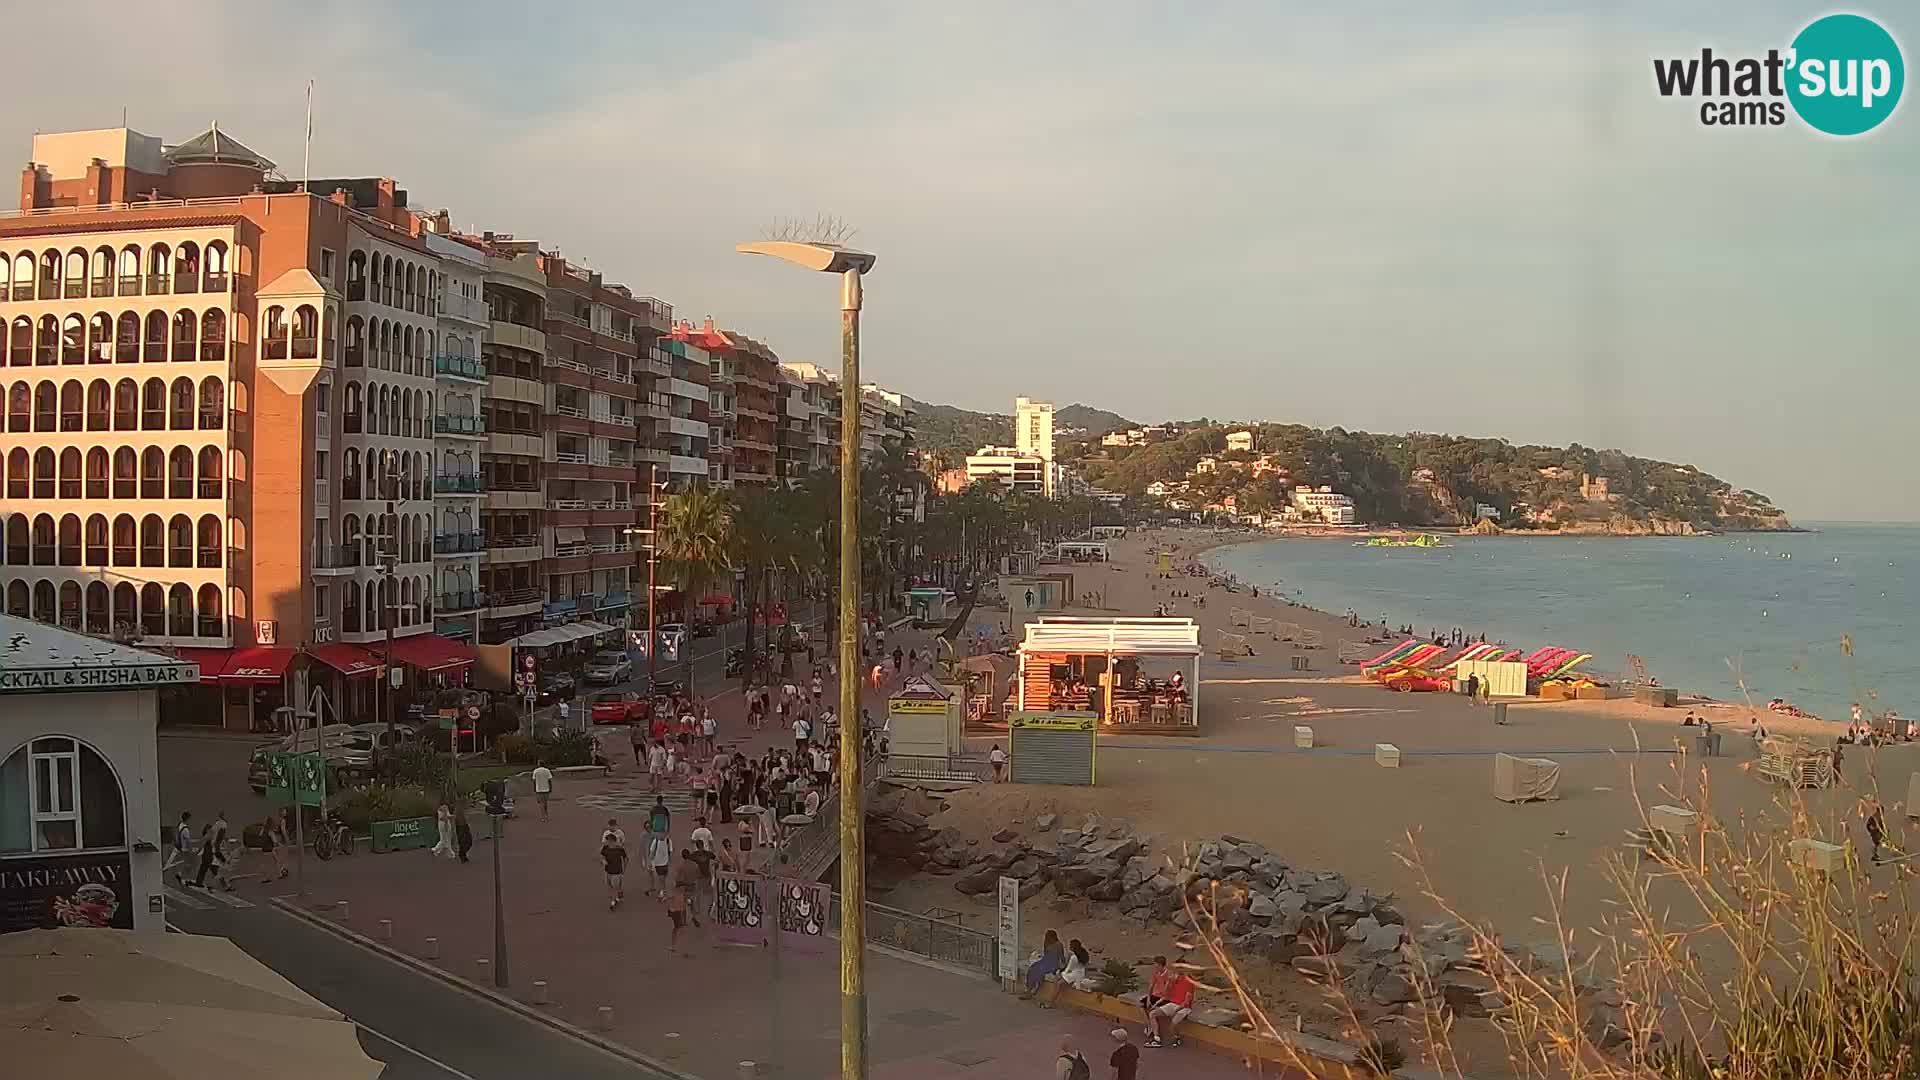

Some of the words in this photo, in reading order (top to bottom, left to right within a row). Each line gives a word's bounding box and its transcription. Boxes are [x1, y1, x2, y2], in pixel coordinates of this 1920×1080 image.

[314, 627, 333, 643] KFC
[63, 671, 74, 685] &
[80, 669, 141, 684] SHISHA
[146, 668, 179, 681] BAR
[234, 667, 272, 675] KFC
